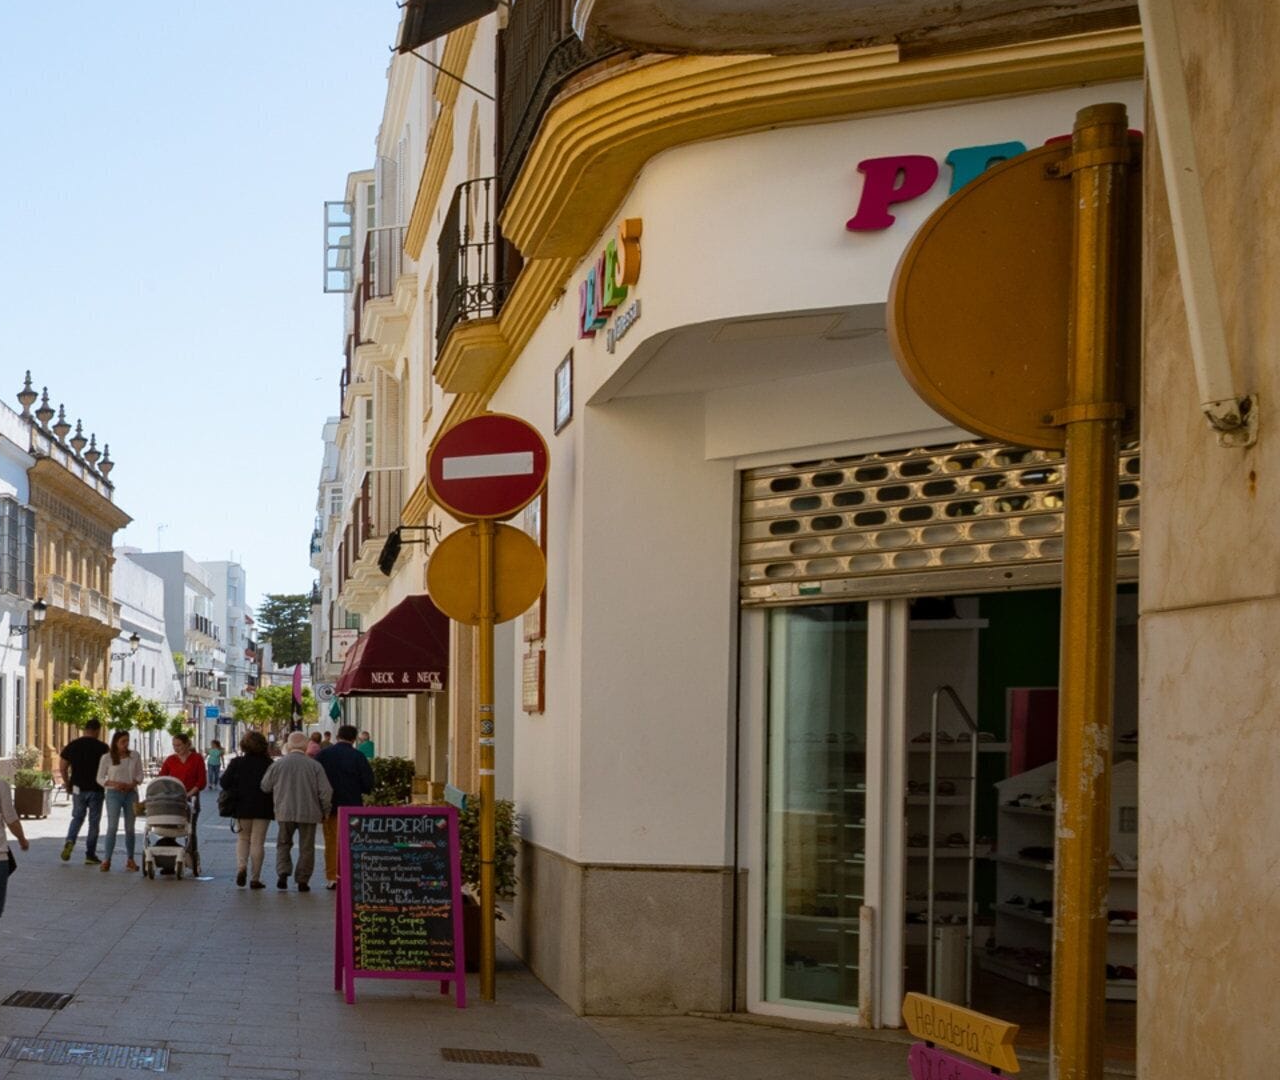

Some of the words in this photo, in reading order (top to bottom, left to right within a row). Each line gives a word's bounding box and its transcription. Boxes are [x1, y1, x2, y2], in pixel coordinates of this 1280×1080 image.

[371, 672, 394, 683] NECK
[402, 672, 410, 683] &
[417, 672, 441, 683] NECK
[361, 814, 434, 833] HELADERÍA
[359, 911, 387, 923] Gofres
